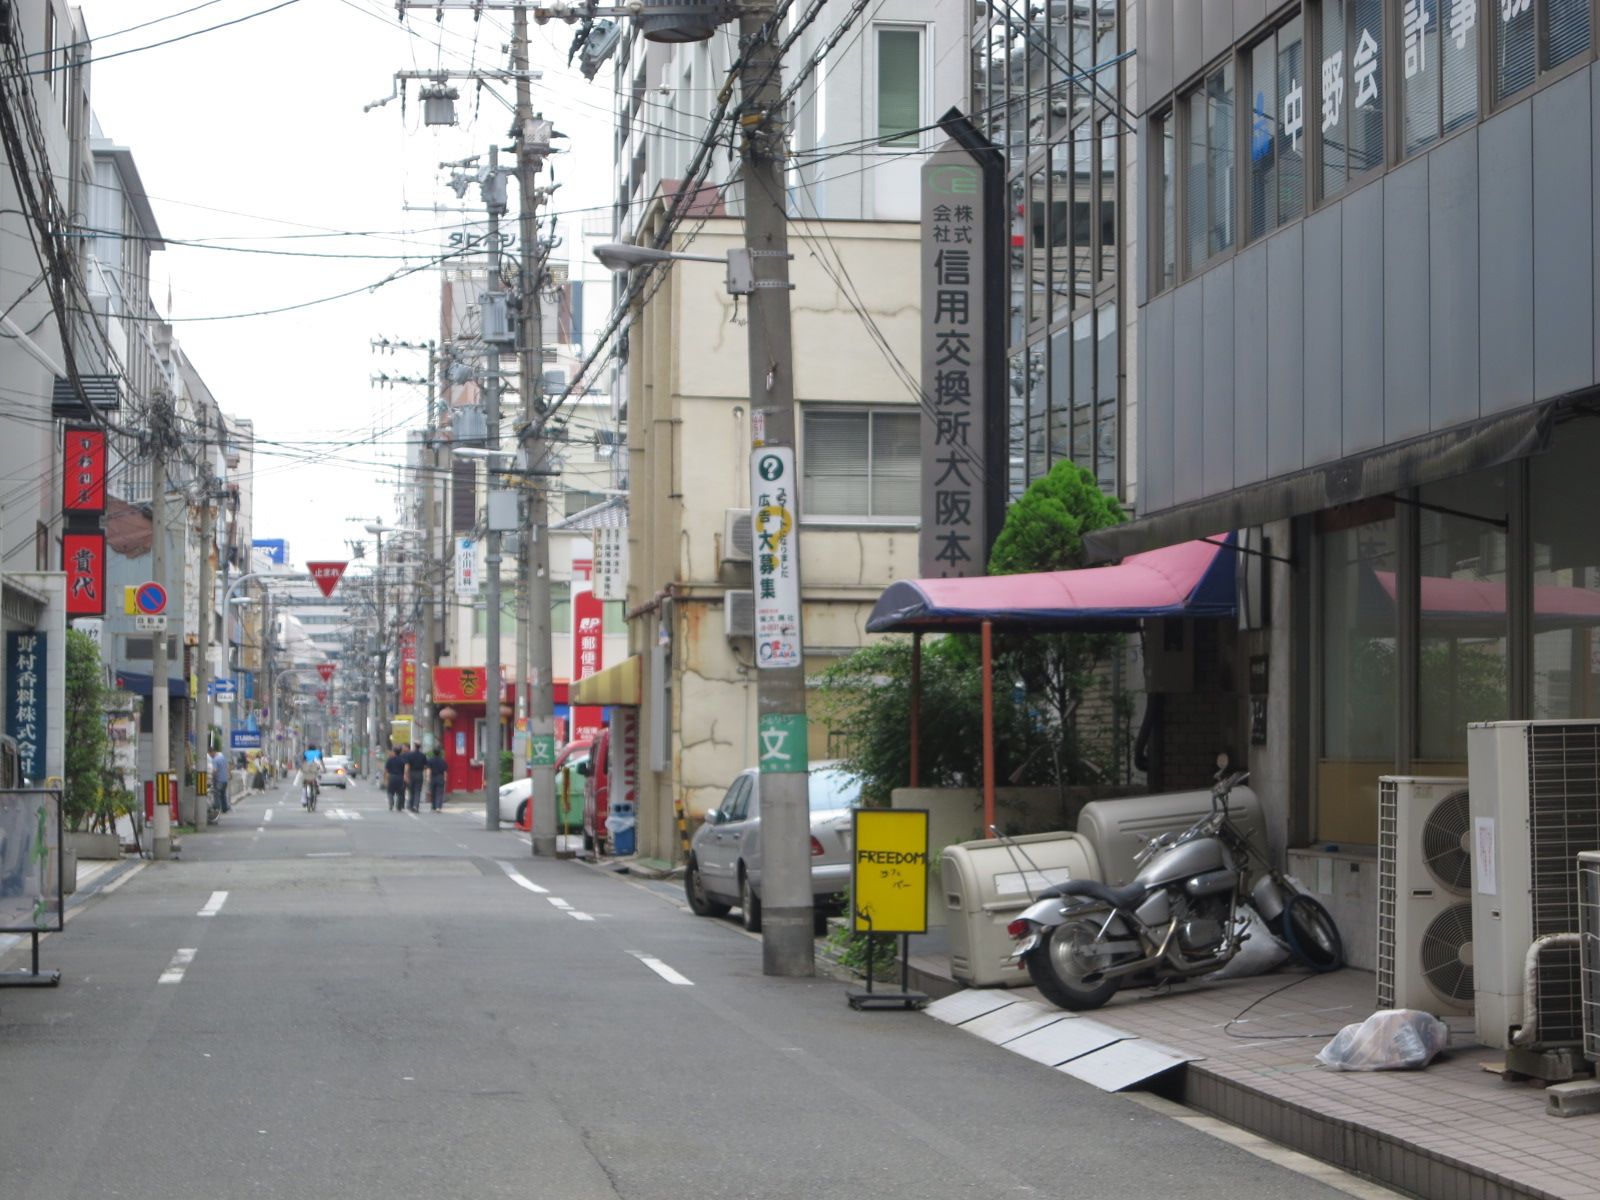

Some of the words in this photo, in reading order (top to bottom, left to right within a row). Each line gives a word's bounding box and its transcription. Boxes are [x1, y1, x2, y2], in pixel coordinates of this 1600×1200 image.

[934, 247, 971, 577] 信用交換所大阪本
[314, 567, 340, 578] 止まれ
[15, 634, 37, 774] 野村香料株式会社
[857, 850, 926, 865] FREEDOM
